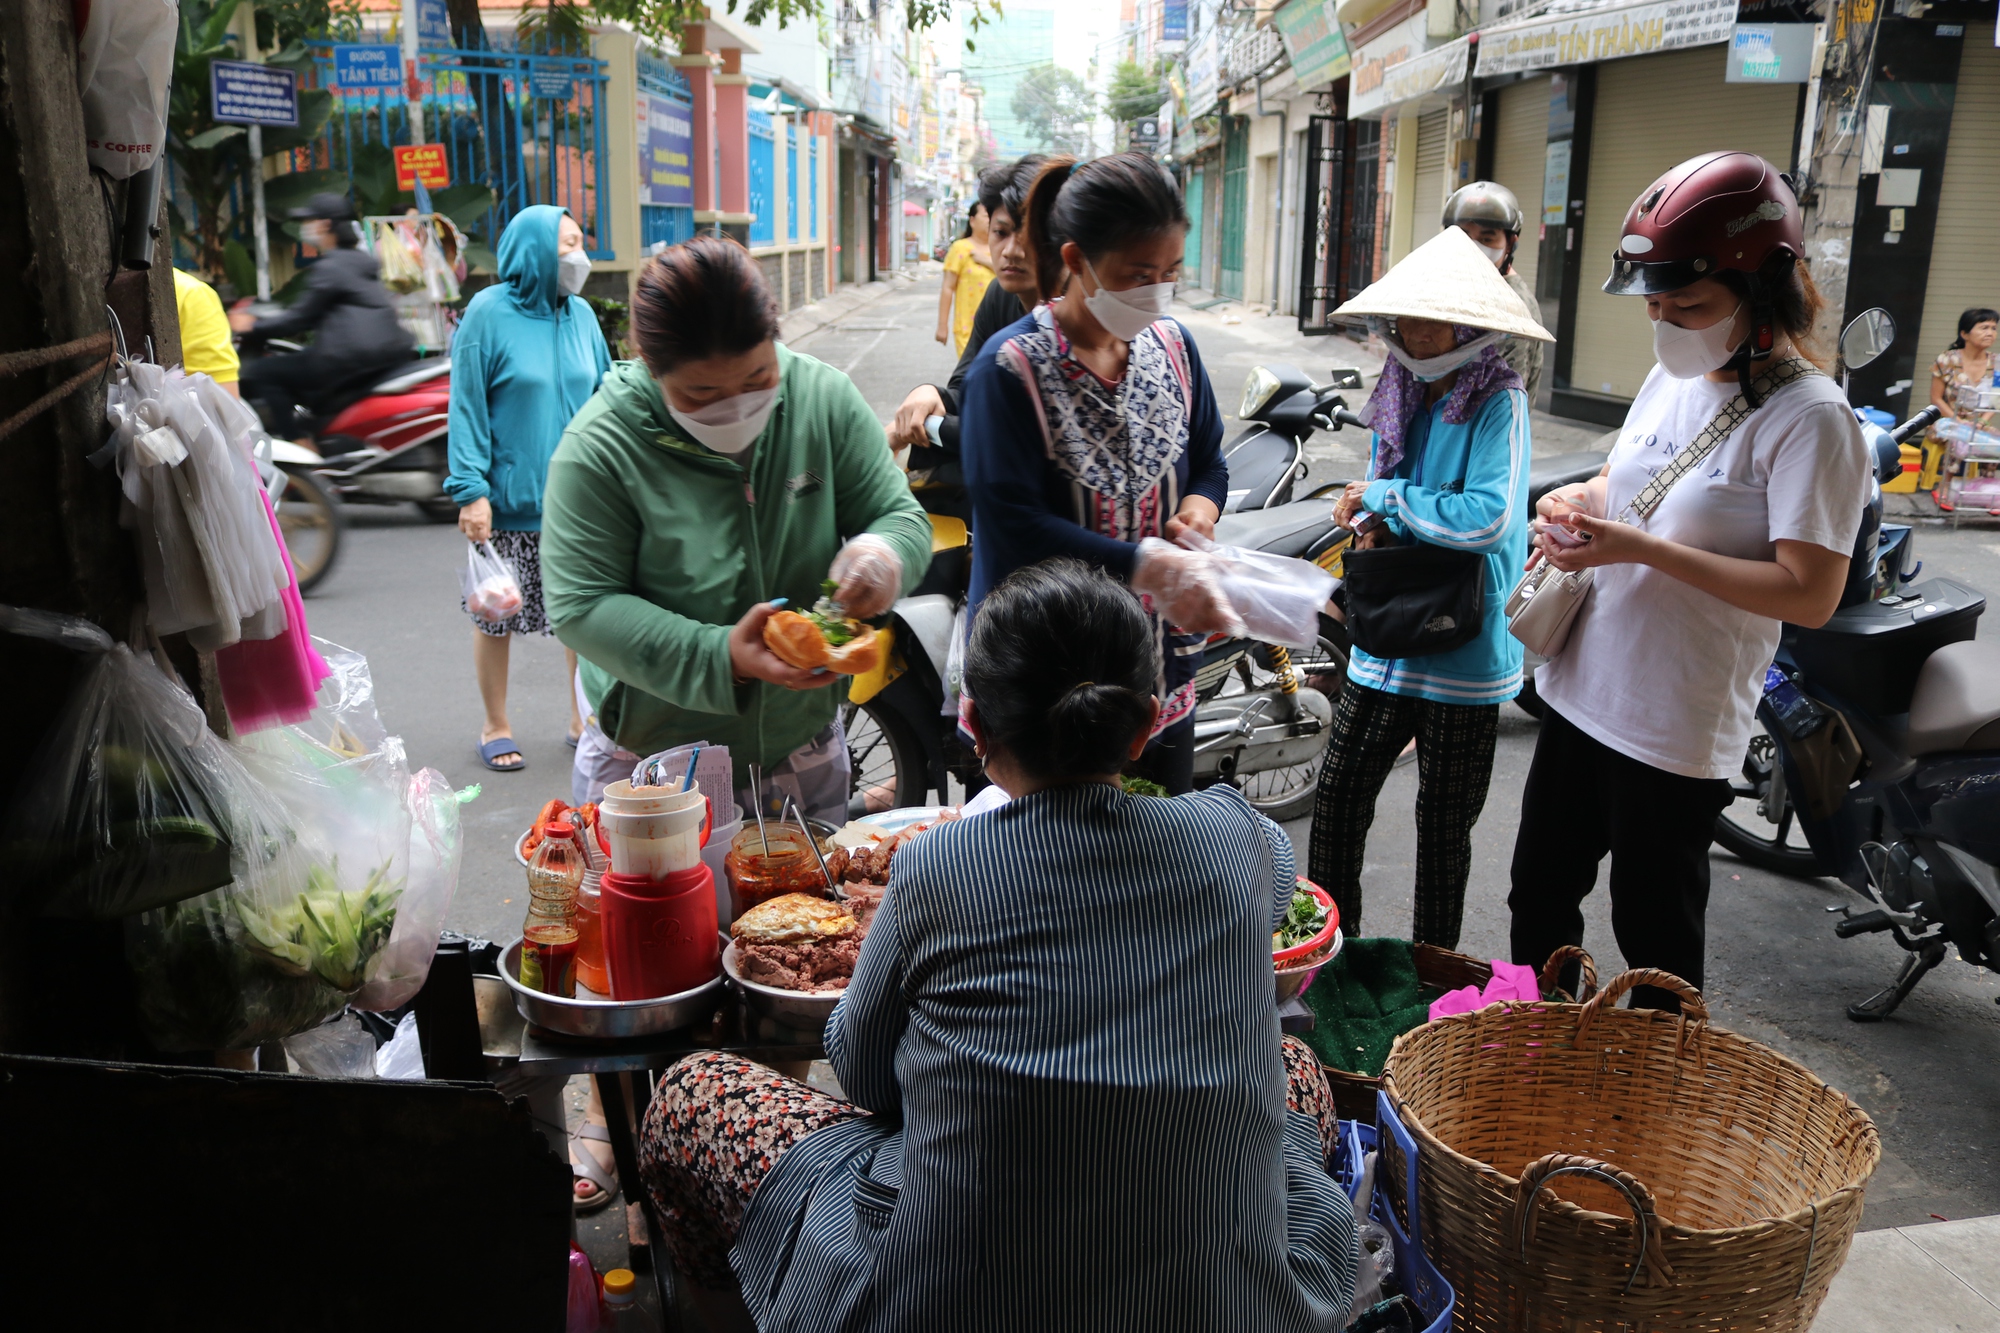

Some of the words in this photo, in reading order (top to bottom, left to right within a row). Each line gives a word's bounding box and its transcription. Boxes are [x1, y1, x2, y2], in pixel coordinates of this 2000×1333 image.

[1558, 21, 1590, 62] TÍN
[1592, 15, 1664, 58] THÀNH
[349, 49, 386, 62] ĐƯỜNG
[339, 66, 368, 84] TÂN
[369, 61, 399, 82] TIẾN
[104, 142, 152, 154] COFFEE
